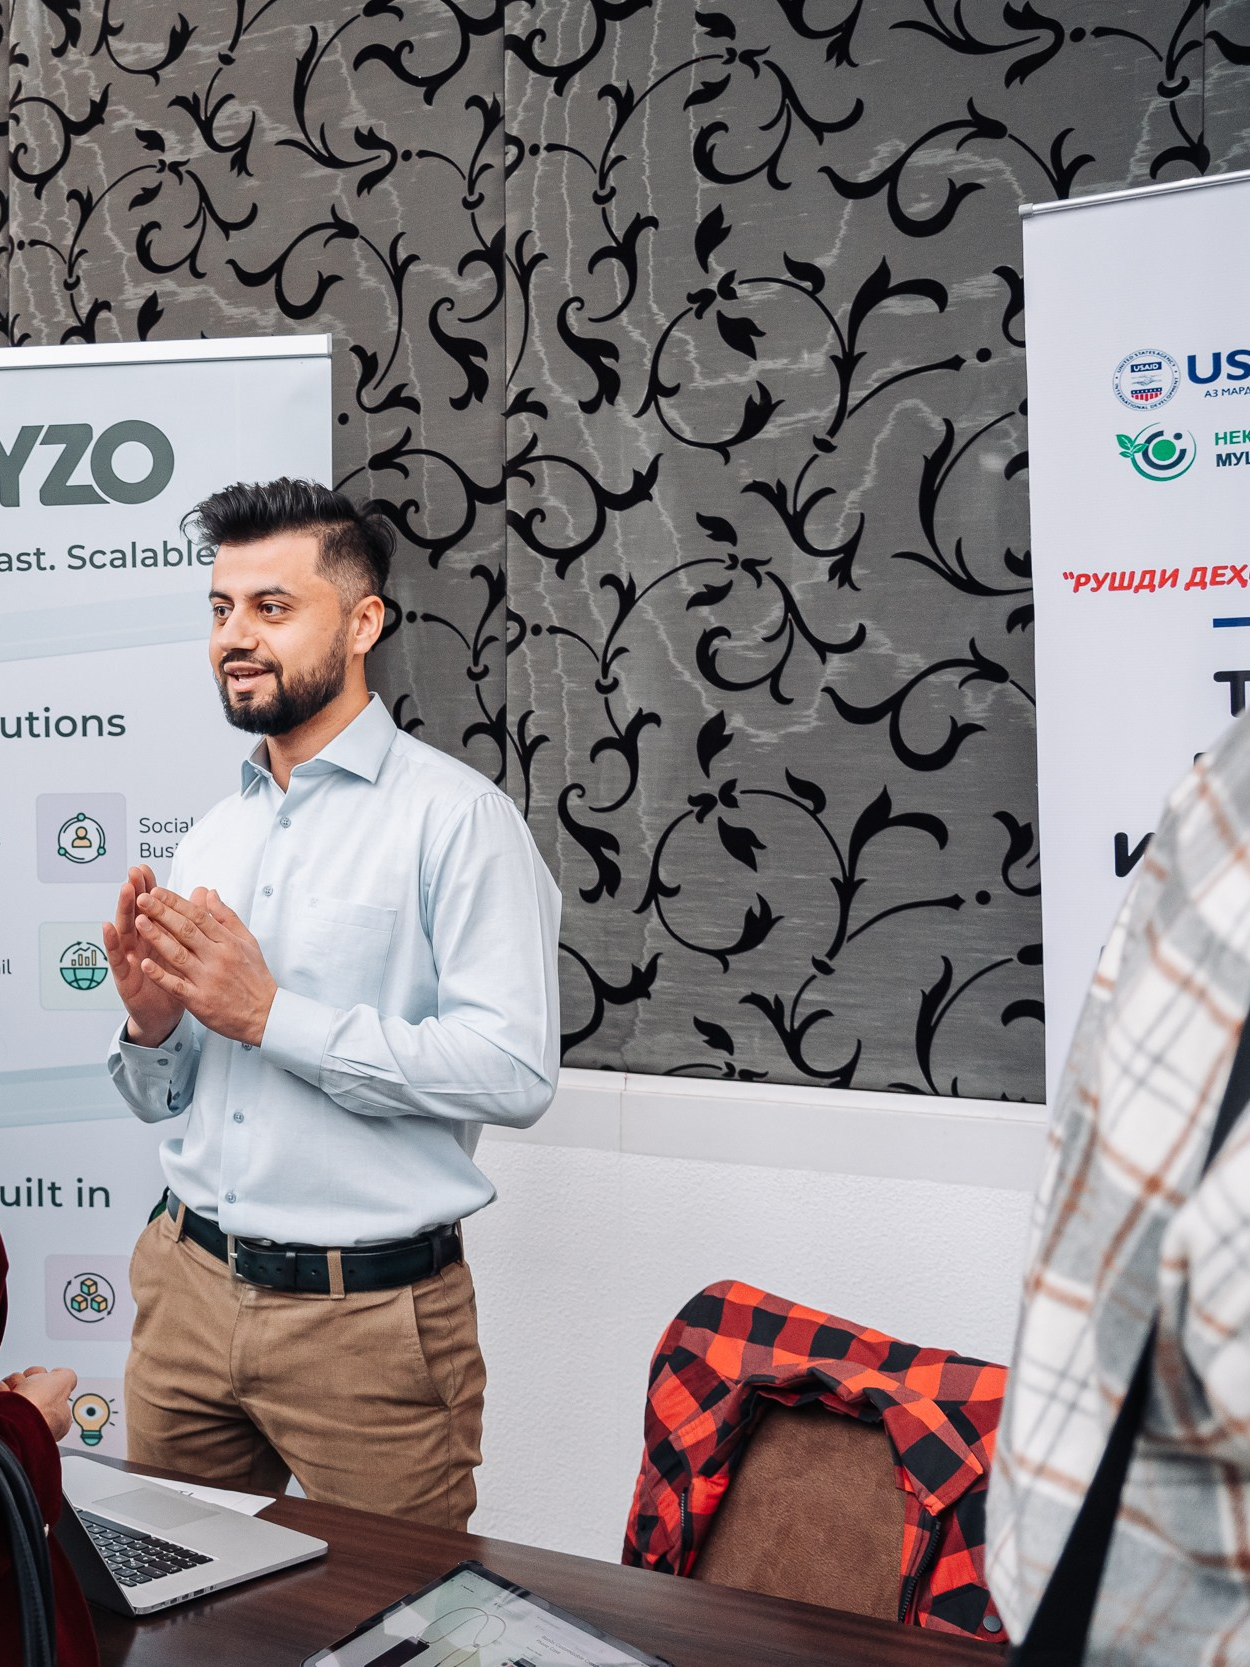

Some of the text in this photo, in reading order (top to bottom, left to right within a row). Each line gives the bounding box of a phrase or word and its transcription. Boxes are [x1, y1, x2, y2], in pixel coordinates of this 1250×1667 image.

[1133, 363, 1159, 371] USAID
[1204, 389, 1219, 398] АЗ
[67, 539, 216, 570] Scalable
[1184, 564, 1250, 591] ДЕҲ
[139, 816, 194, 834] Social
[140, 842, 178, 858] Bus
[76, 1177, 110, 1208] in
